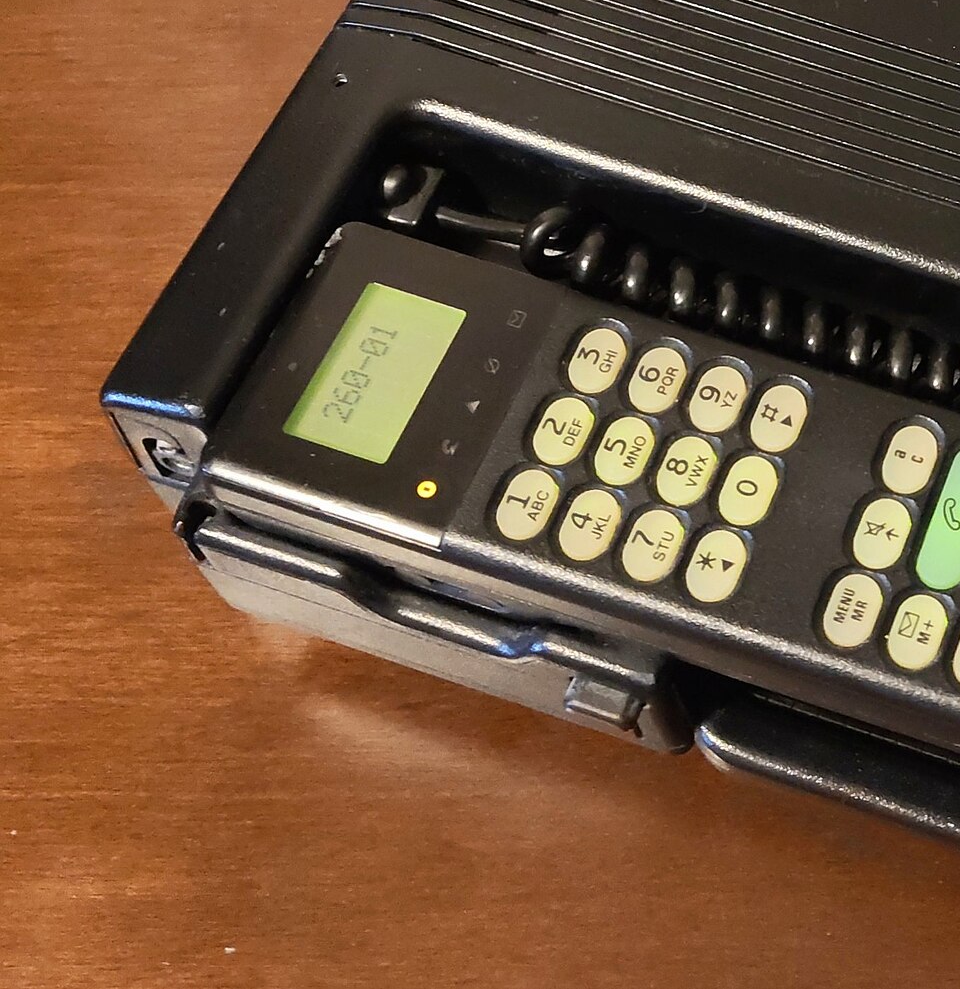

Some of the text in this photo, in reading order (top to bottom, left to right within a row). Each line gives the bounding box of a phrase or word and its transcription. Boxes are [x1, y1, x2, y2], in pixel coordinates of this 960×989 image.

[577, 346, 598, 365] 3
[600, 350, 618, 373] GHI
[322, 326, 398, 424] 260-01
[639, 366, 660, 382] 6
[658, 367, 679, 395] PQR
[700, 385, 720, 402] 9
[720, 391, 738, 409] YZ
[542, 418, 566, 435] 2
[563, 419, 582, 447] DEF
[605, 438, 626, 457] 5
[625, 436, 646, 469] MNO
[666, 459, 688, 475] 8
[686, 455, 708, 487] VWX
[737, 480, 758, 496] 0
[507, 493, 530, 508] 1
[528, 490, 549, 521] ABC
[571, 512, 592, 528] 4
[592, 515, 611, 539] JKL
[632, 530, 654, 546] 7
[653, 531, 674, 562] STU
[834, 588, 854, 623] MENU
[851, 601, 868, 621] MR
[918, 620, 934, 644] M+
